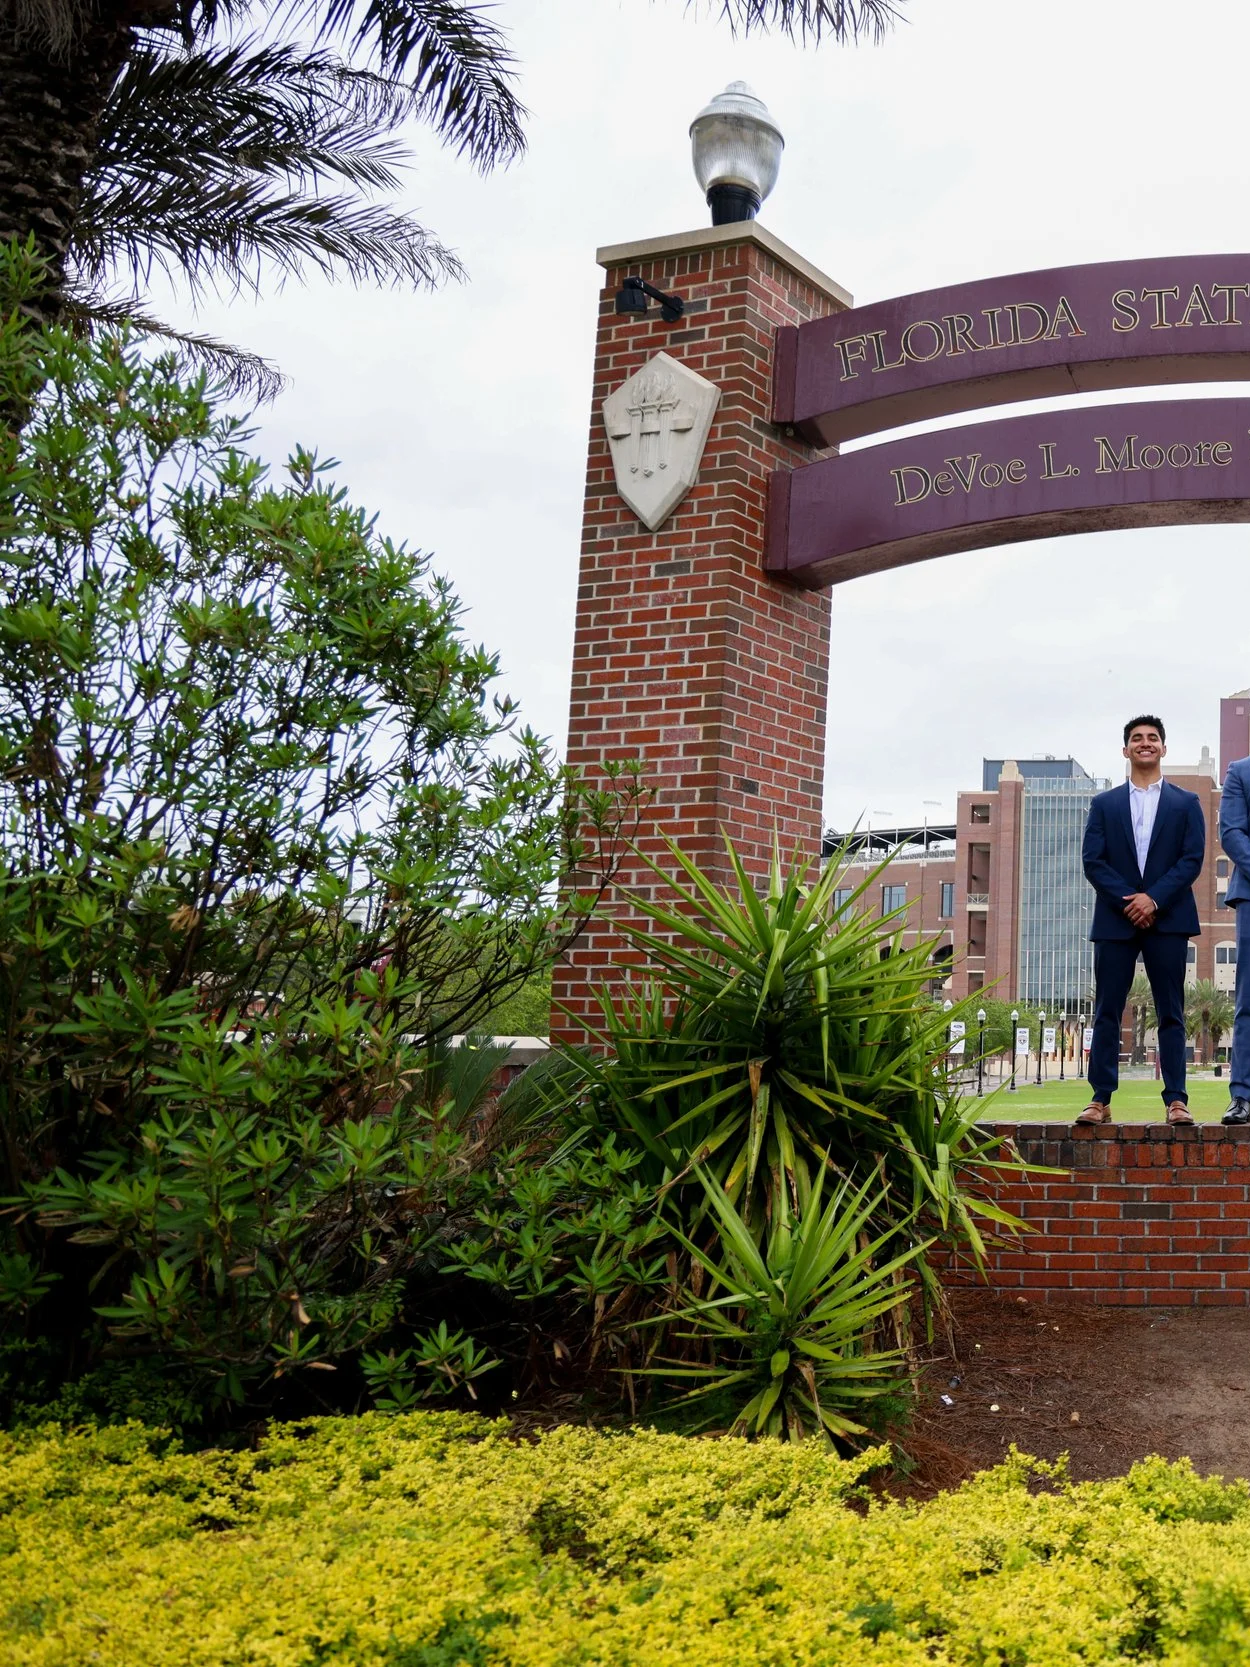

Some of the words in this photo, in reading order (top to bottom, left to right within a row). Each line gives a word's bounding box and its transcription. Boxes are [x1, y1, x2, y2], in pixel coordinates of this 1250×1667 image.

[834, 296, 1086, 381] FLORIDA
[890, 453, 1027, 506] DeVoe
[1039, 443, 1080, 480] L.
[1094, 434, 1233, 474] Moore
